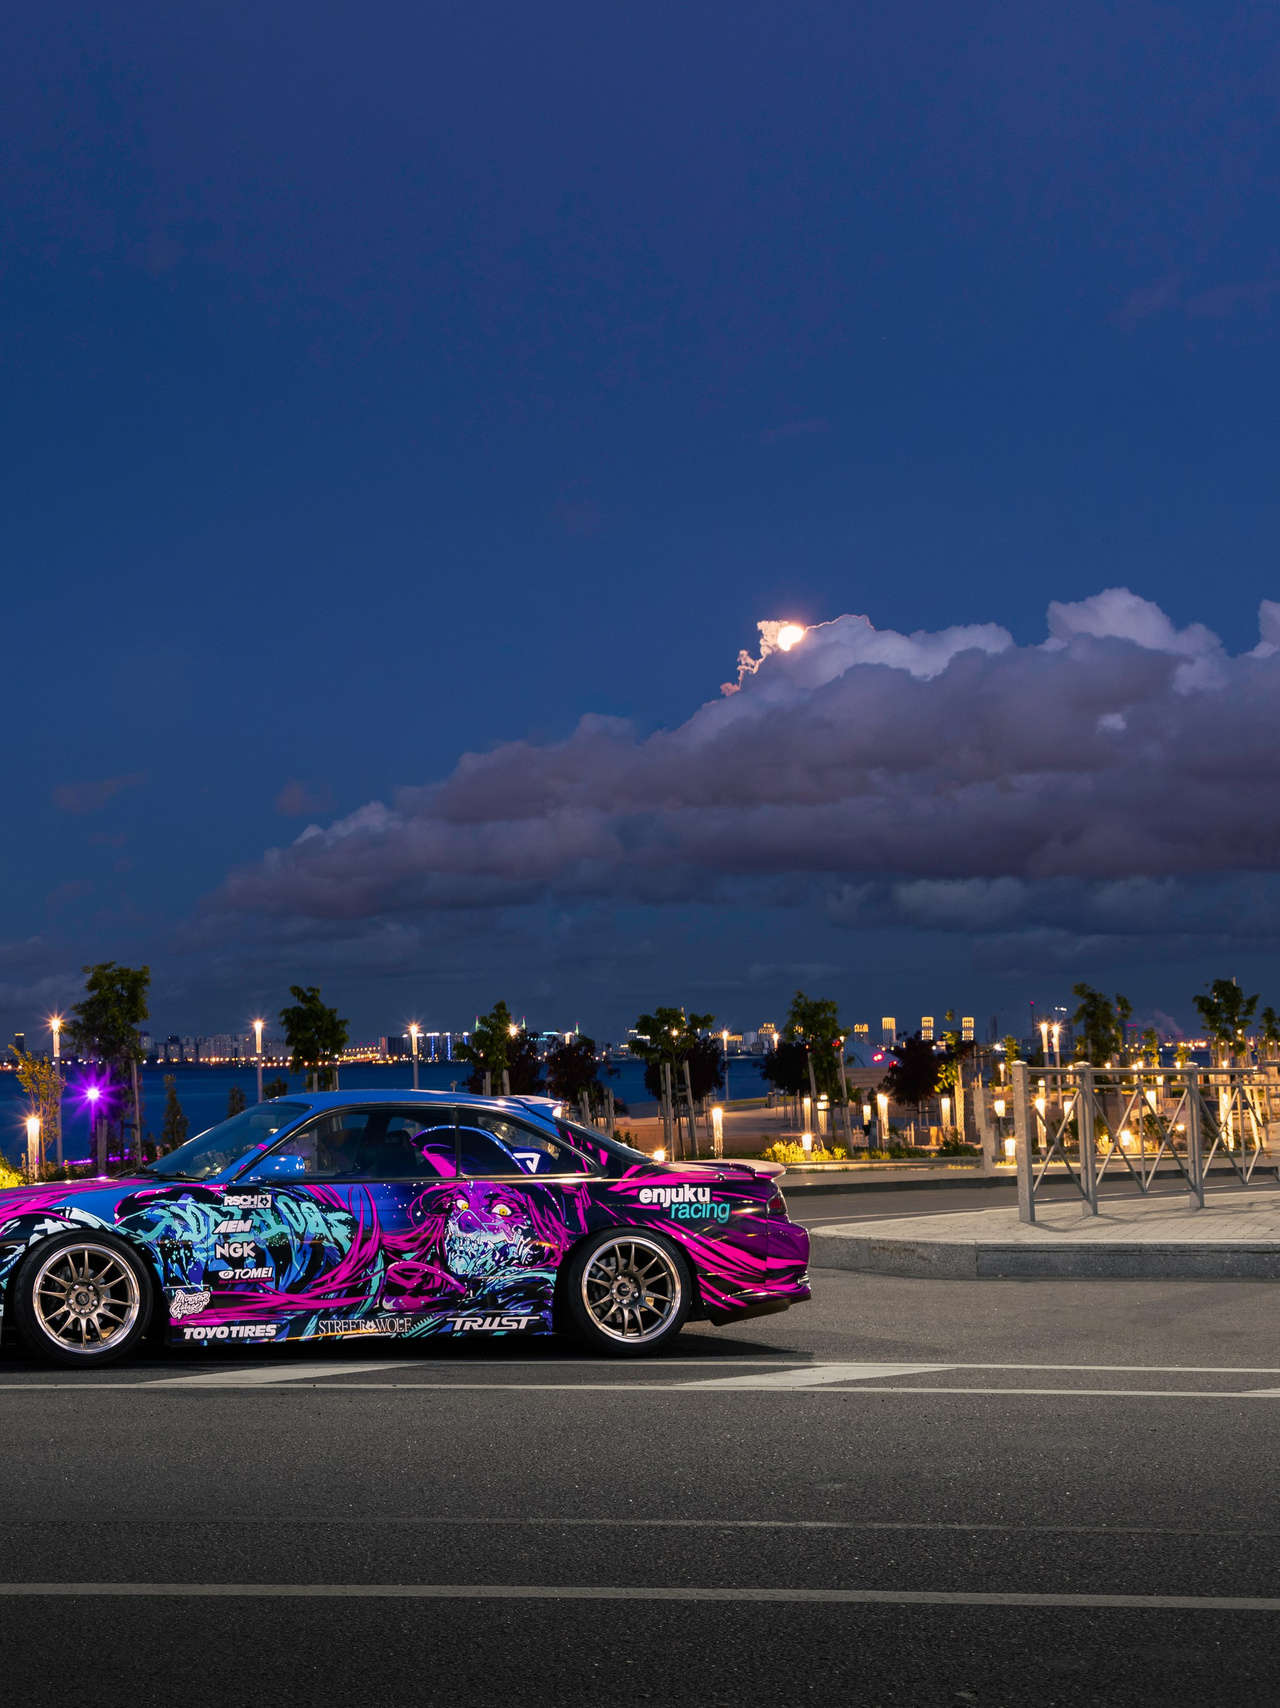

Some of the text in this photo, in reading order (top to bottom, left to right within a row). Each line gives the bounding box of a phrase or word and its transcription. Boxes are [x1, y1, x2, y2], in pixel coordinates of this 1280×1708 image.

[224, 1195, 257, 1206] RSCH
[639, 1184, 710, 1207] enjuku
[671, 1202, 730, 1223] racing
[213, 1220, 252, 1233] AEM
[215, 1242, 255, 1258] NGK
[234, 1267, 273, 1279] TOMEI
[318, 1318, 412, 1334] STREET WOLF
[446, 1316, 540, 1330] TRUST
[183, 1324, 277, 1339] TOYO TIRES
